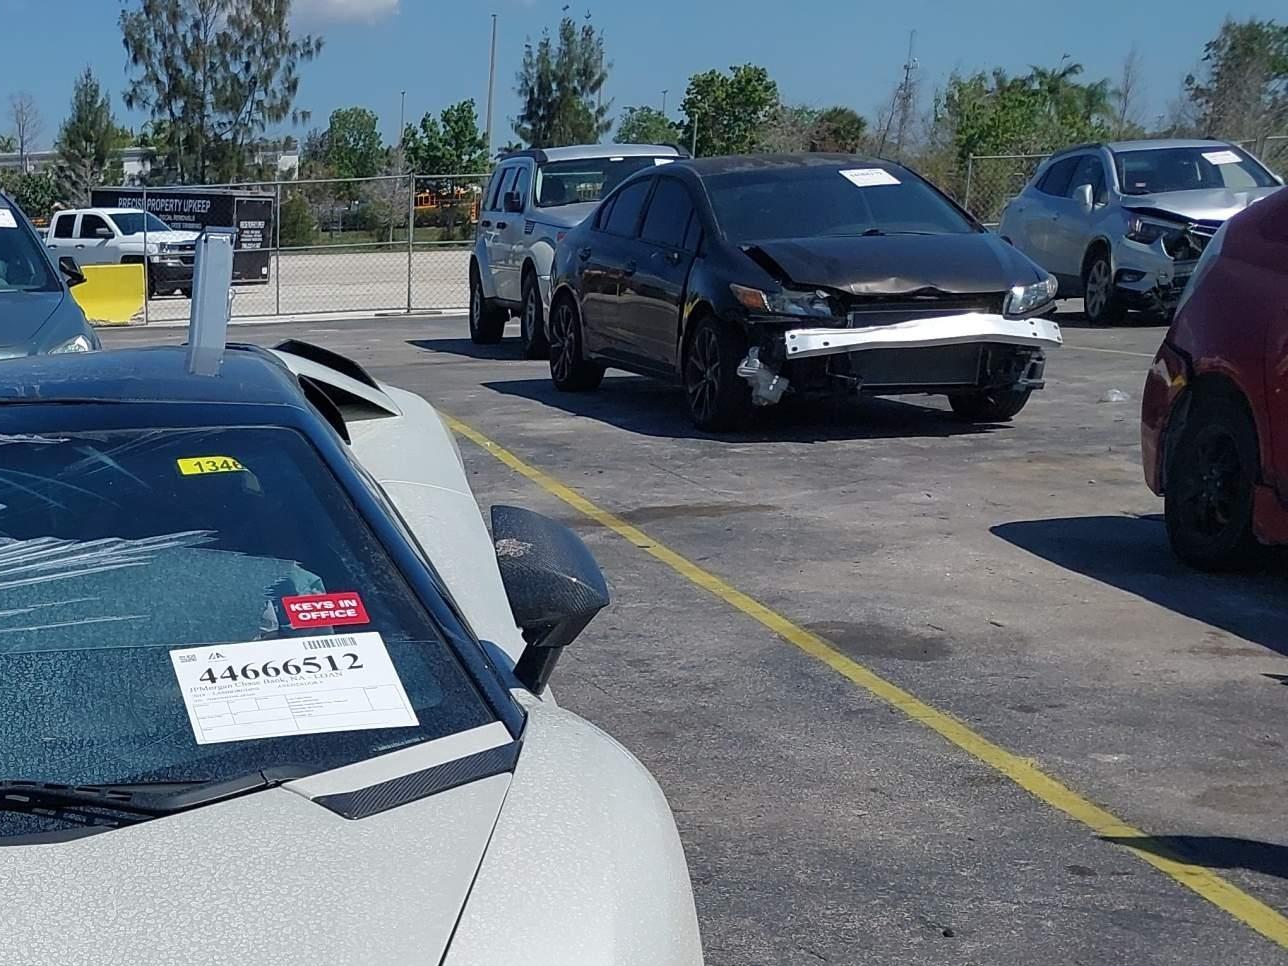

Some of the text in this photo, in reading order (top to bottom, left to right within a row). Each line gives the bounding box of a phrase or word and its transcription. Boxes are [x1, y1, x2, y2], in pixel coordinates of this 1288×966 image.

[147, 198, 182, 211] PROPERTY
[184, 199, 211, 213] UPKEEP
[290, 599, 358, 612] KEYS IN
[298, 608, 358, 621] OFFICE
[199, 652, 364, 684] 44666512
